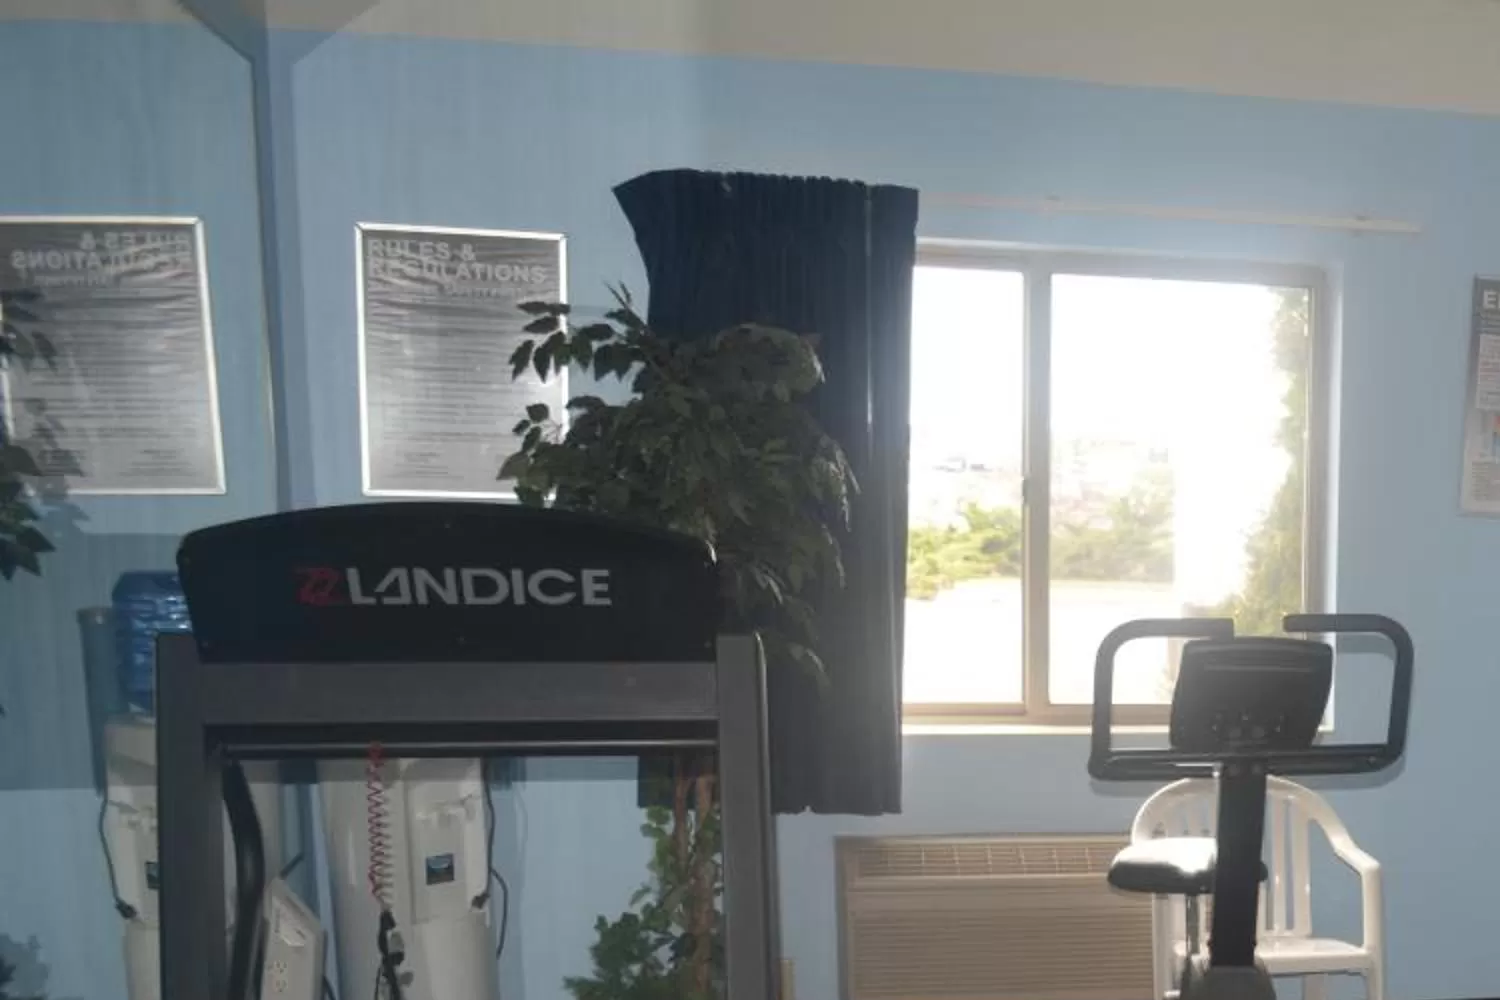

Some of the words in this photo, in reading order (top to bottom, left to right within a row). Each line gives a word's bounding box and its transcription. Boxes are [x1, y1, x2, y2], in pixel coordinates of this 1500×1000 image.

[367, 239, 451, 260] RULES
[460, 243, 477, 261] &
[368, 257, 547, 284] REGULATIONS
[345, 566, 612, 606] LANDICE
